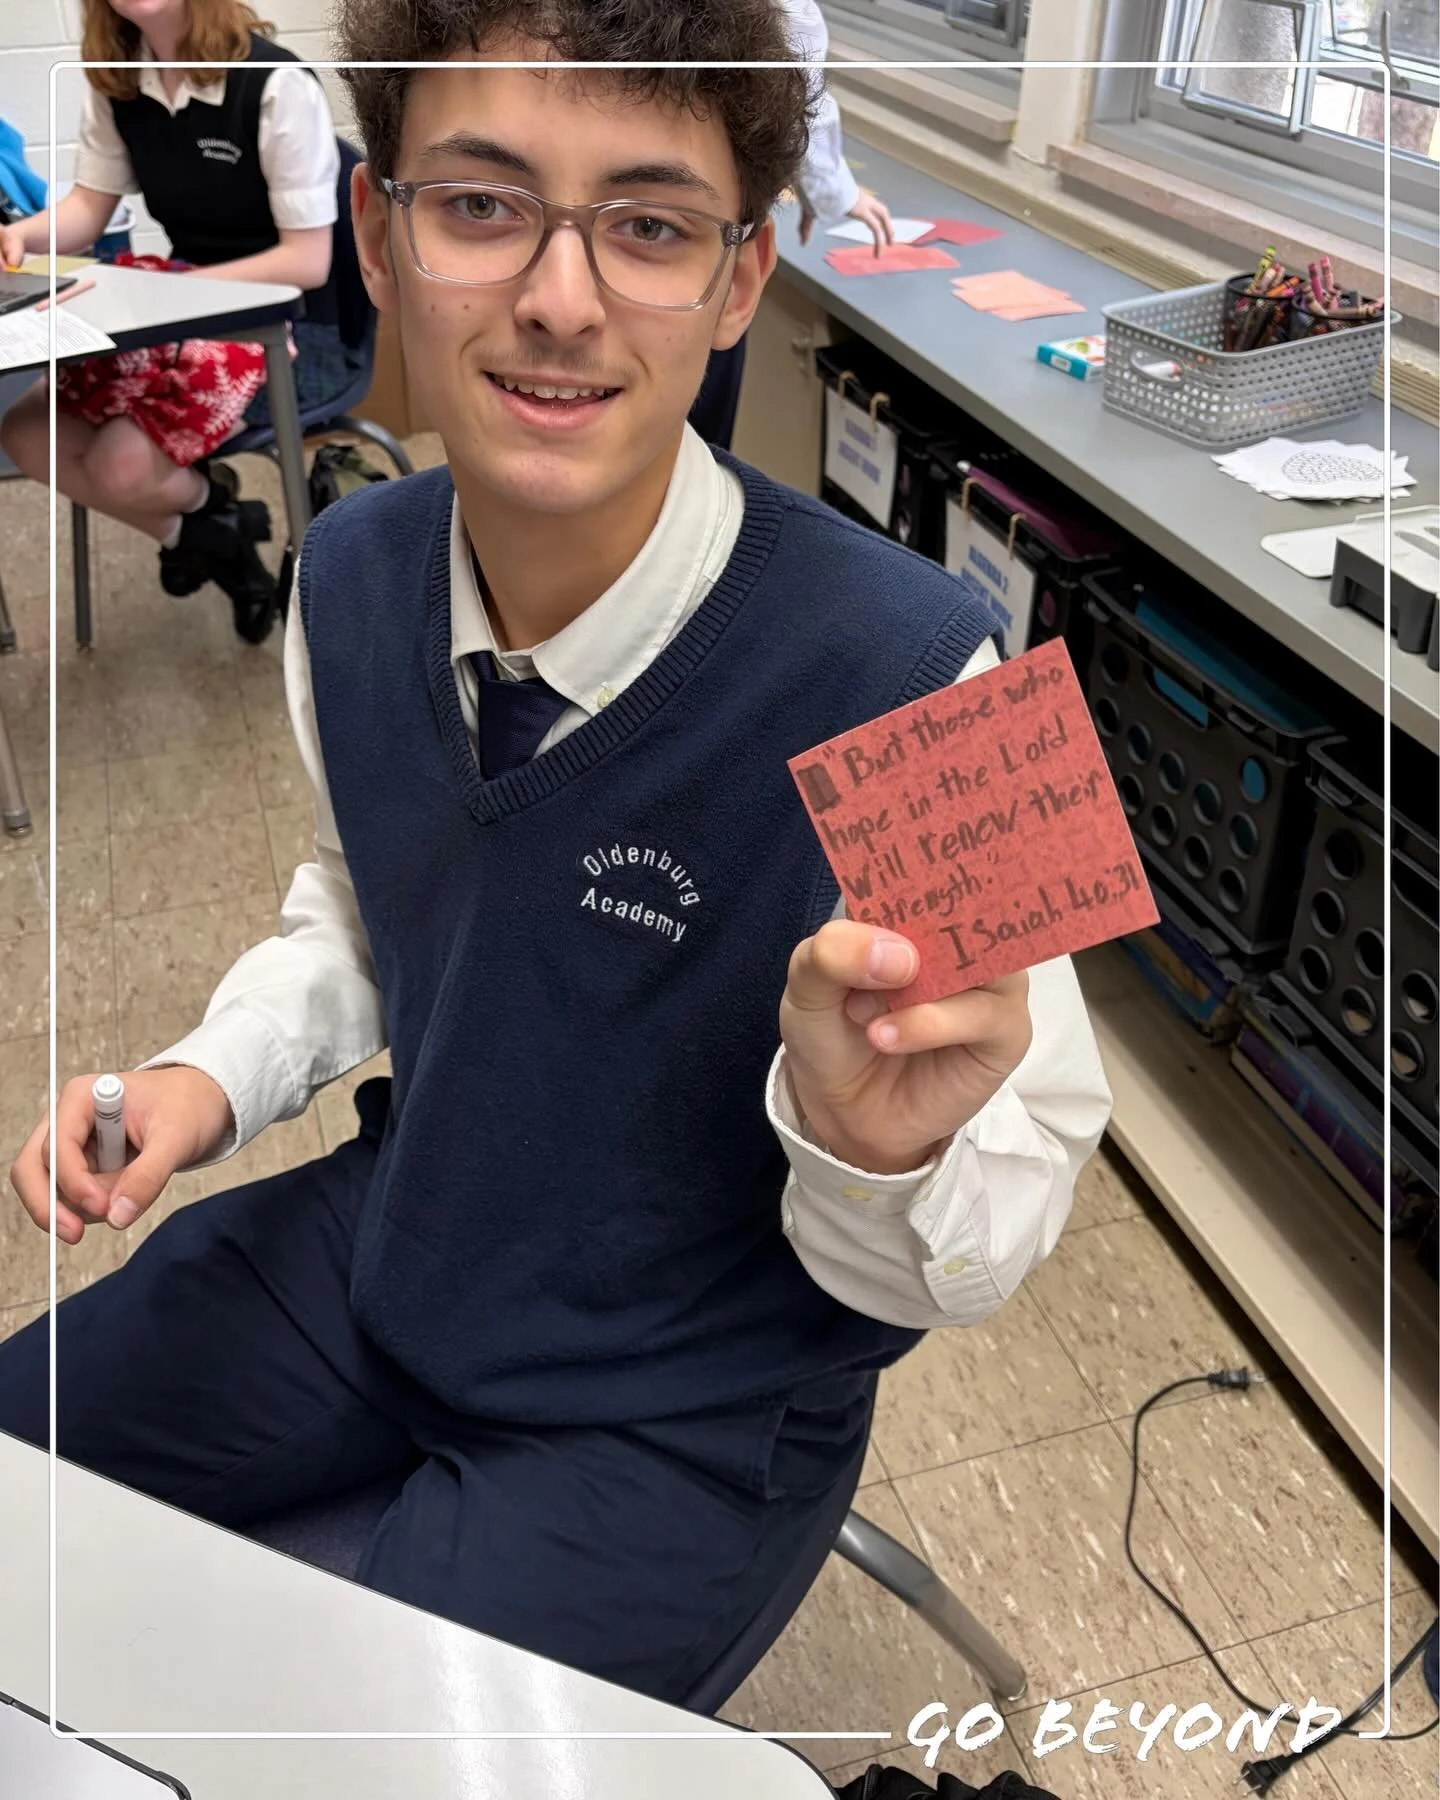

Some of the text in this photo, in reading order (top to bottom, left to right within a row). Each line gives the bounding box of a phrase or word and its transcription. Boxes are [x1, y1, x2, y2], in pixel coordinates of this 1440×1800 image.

[909, 695, 996, 751] those
[1003, 665, 1064, 704] who
[819, 712, 1068, 854] hope in the Lord
[917, 800, 1018, 866] renew
[1029, 769, 1104, 820] their
[580, 887, 687, 942] Academy
[583, 842, 700, 906] Oldenburg
